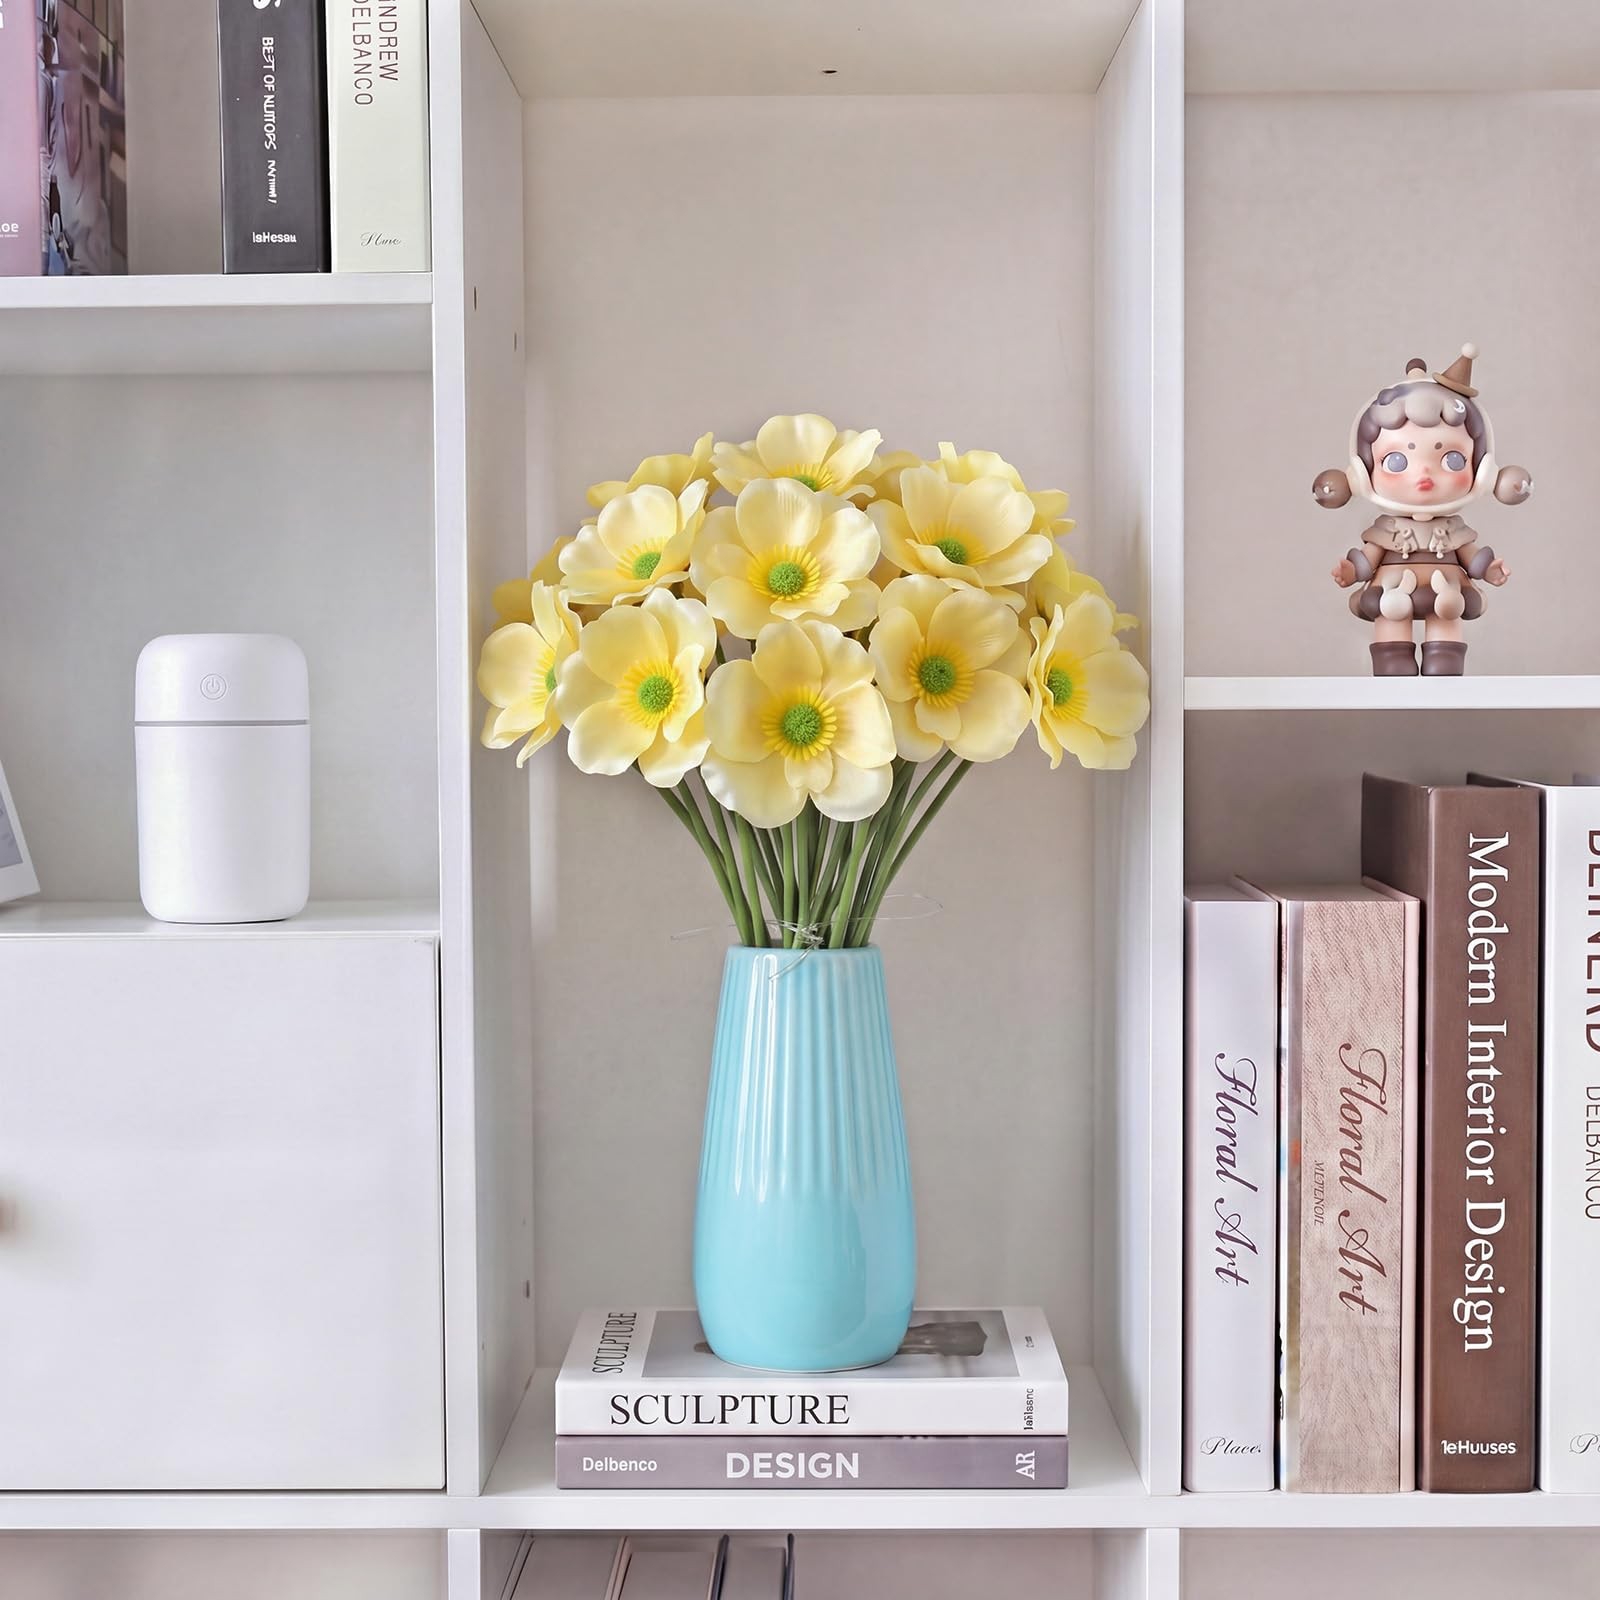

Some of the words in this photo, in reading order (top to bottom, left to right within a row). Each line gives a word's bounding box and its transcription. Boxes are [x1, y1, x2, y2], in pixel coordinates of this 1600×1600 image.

[377, 0, 399, 81] NDREW
[1466, 831, 1509, 1007] Modern
[1213, 1052, 1259, 1192] Floral
[1338, 1043, 1388, 1203] Floral
[1465, 1020, 1507, 1185] Interior
[1213, 1197, 1259, 1288] Art
[1337, 1209, 1388, 1316] Art
[1452, 1197, 1507, 1353] Design
[592, 1312, 638, 1374] SCULPTURE
[609, 1394, 850, 1426] SCULPTURE
[581, 1456, 658, 1472] Delbenco
[725, 1452, 860, 1479] DESIGN
